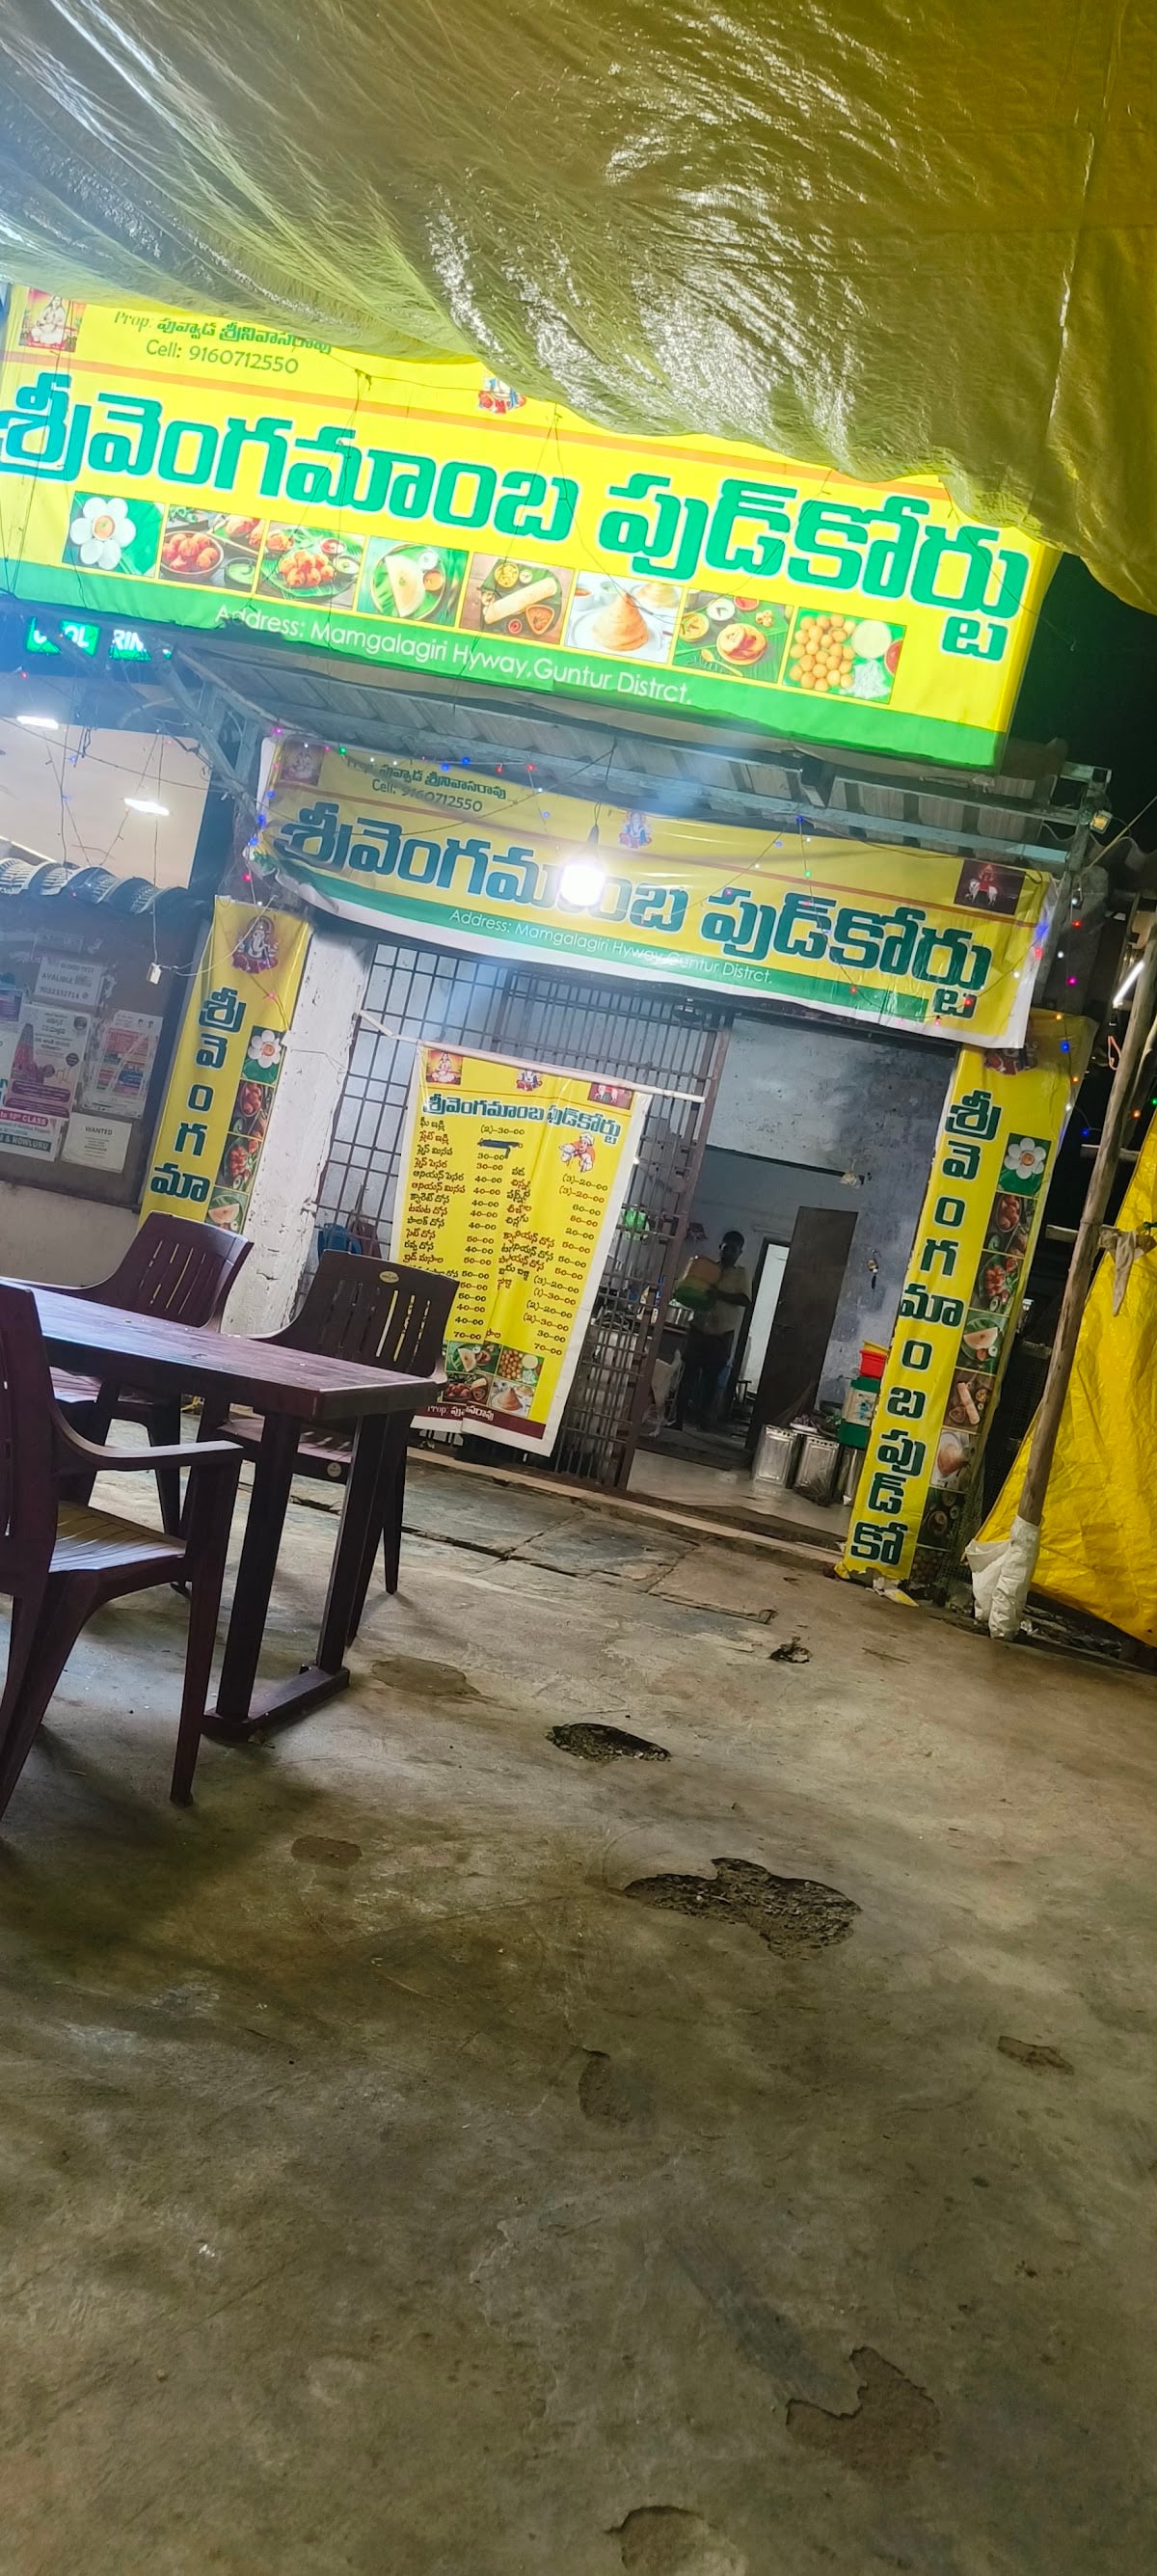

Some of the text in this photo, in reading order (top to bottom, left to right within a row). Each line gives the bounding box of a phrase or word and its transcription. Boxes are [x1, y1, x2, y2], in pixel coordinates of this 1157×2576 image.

[146, 339, 299, 375] Cell: 9160712550
[310, 621, 448, 665] Mamgalagiri
[372, 778, 483, 813] Cell: 9160712550
[273, 800, 688, 933] శ్రీవెంగమంబ
[449, 908, 512, 935] Address:
[515, 923, 609, 954] Mamgalagiri
[85, 1126, 113, 1136] WANTED
